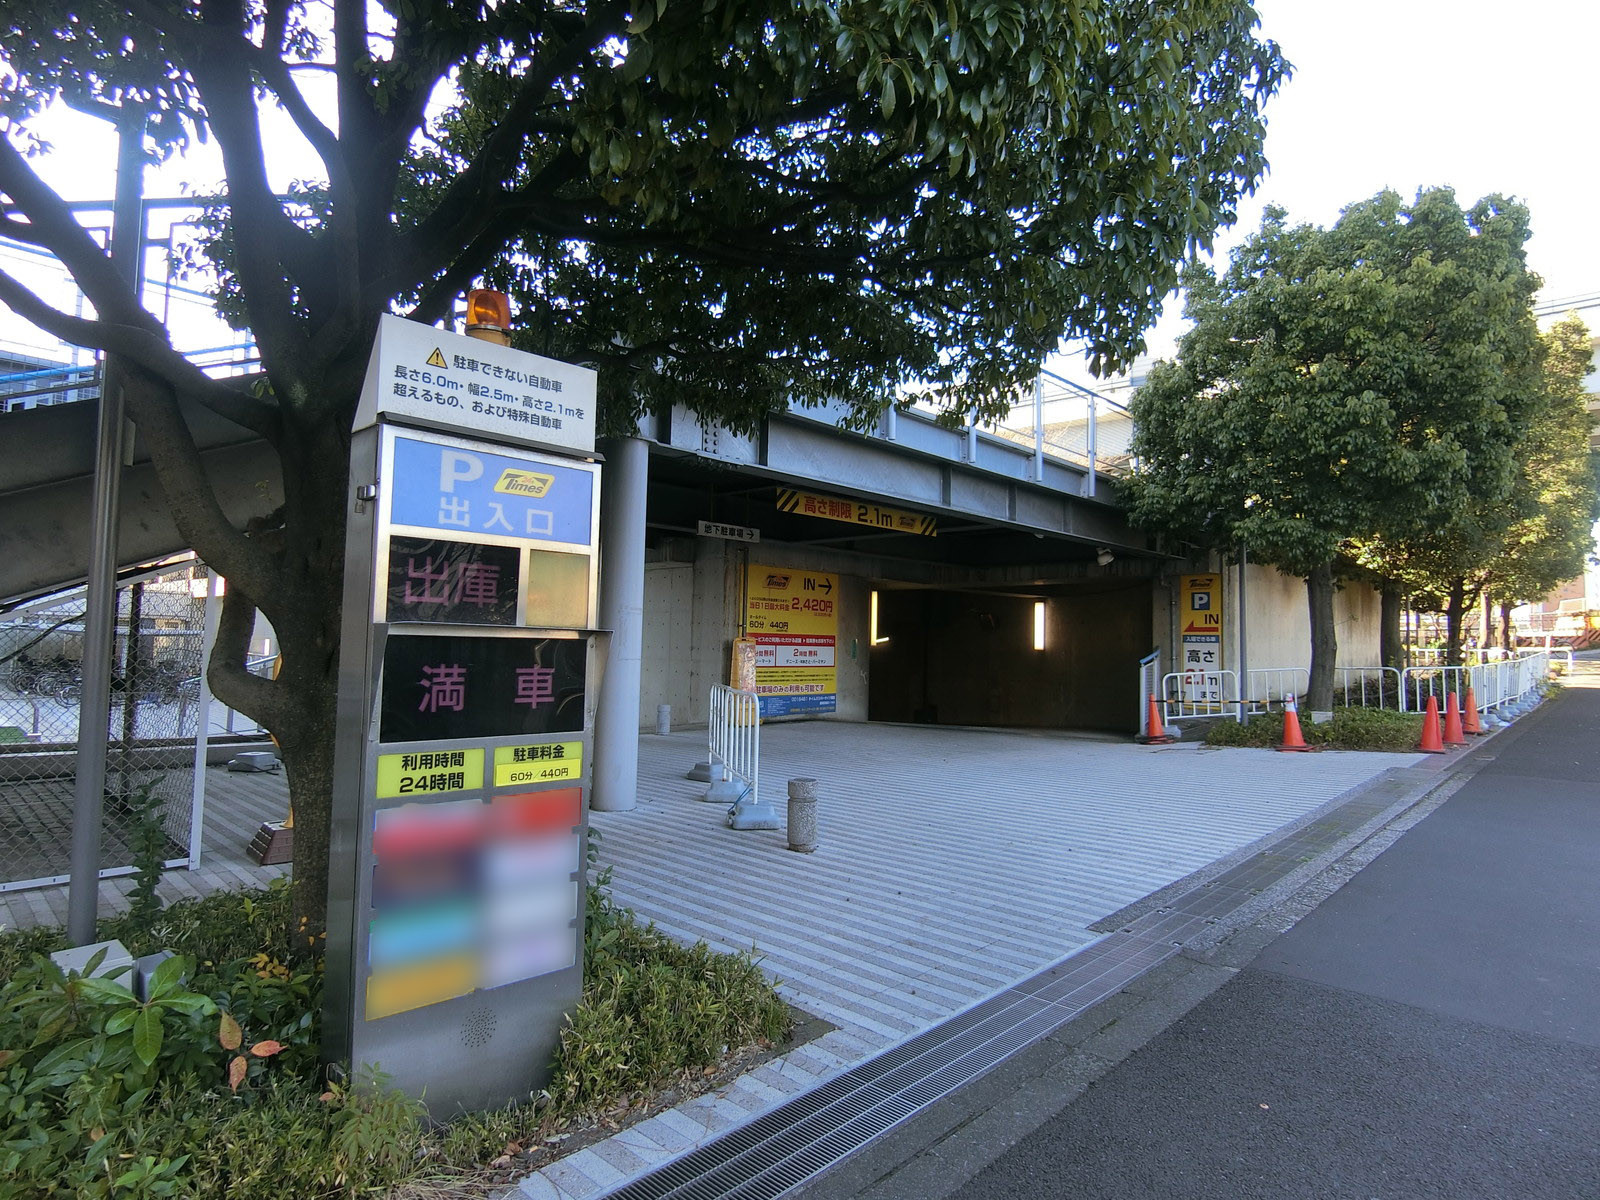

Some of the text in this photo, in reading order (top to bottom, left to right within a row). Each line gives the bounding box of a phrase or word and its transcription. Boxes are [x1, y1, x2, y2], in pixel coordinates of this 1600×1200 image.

[453, 354, 563, 393] 駐車できない自動車
[393, 382, 563, 431] 超えるもの、および特殊自動車
[439, 449, 484, 493] P
[503, 473, 549, 494] Times
[438, 496, 554, 536] 出入口
[804, 495, 893, 527] 高さ制限 2.1m
[704, 523, 744, 538] 地下駐車場
[404, 556, 501, 608] 出庫
[803, 577, 816, 591] IN
[791, 597, 833, 613] 2,420円
[1194, 593, 1208, 609] P
[1204, 613, 1219, 624] IN
[1187, 649, 1215, 663] 高さ
[401, 751, 465, 771] 利用時間
[513, 744, 565, 762] 駐車料金
[399, 772, 465, 793] 24時間
